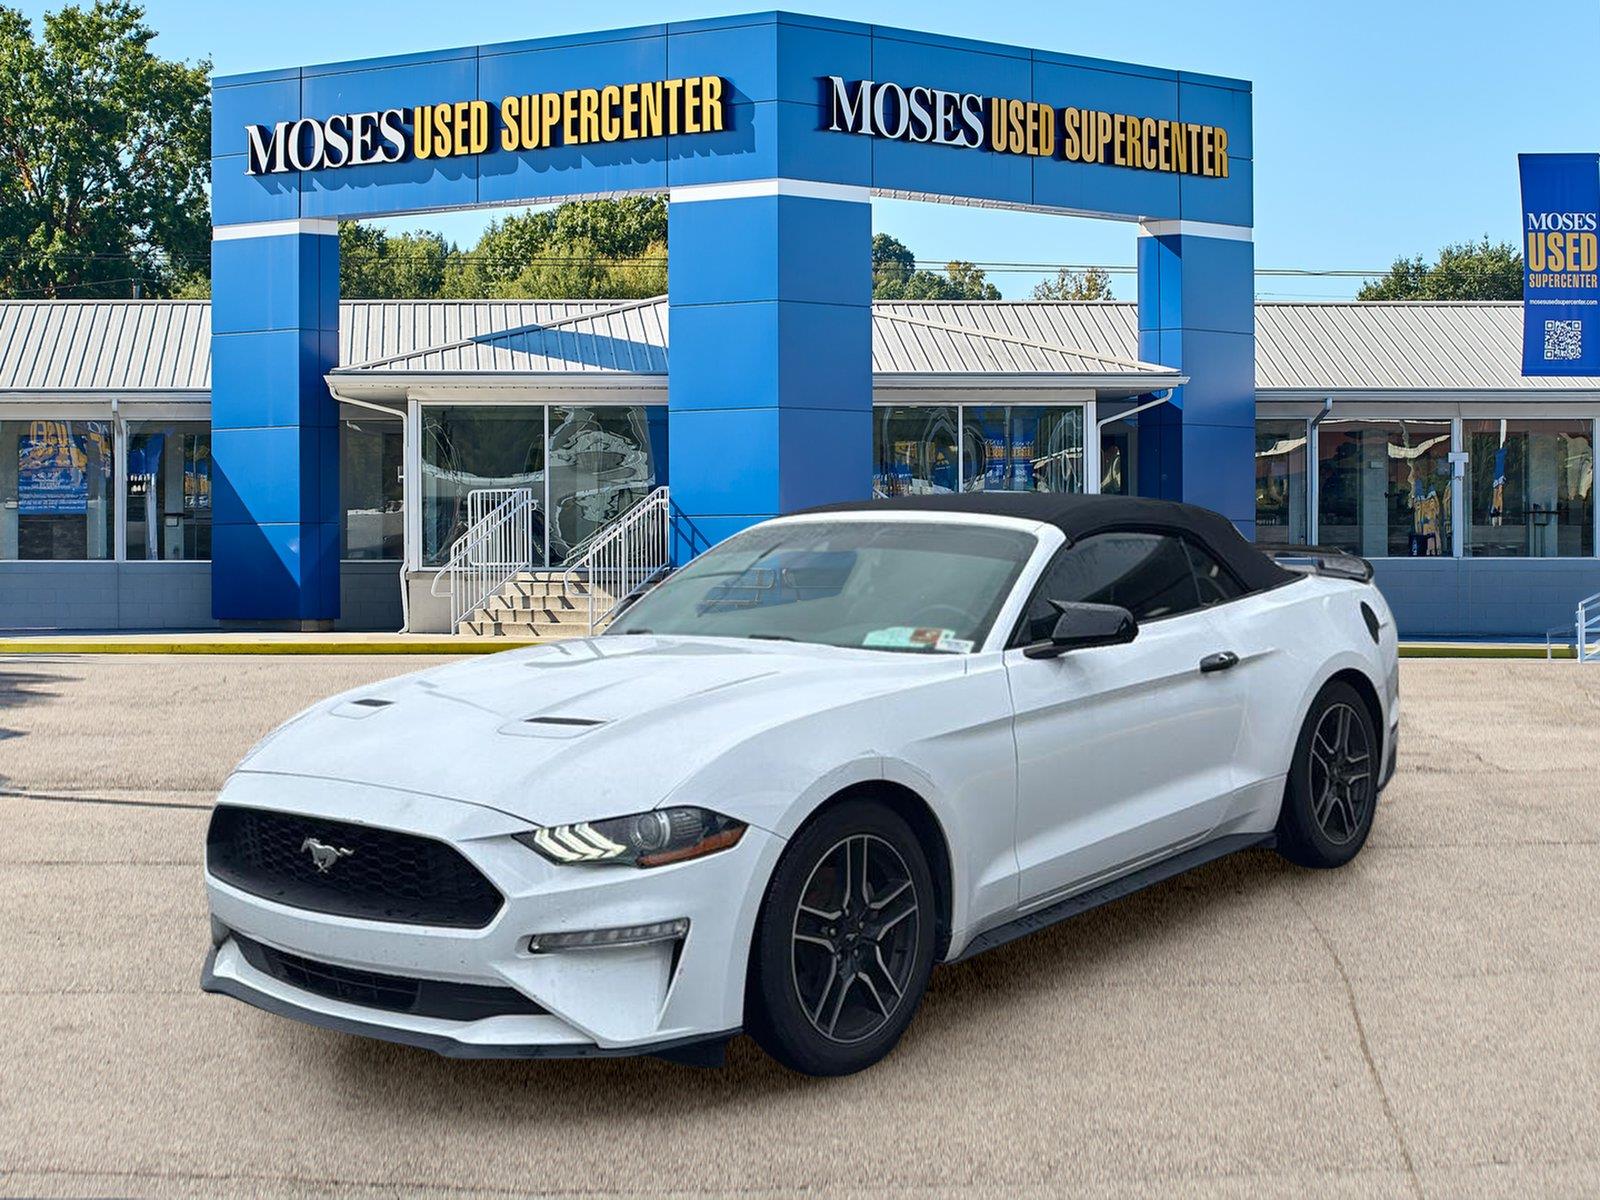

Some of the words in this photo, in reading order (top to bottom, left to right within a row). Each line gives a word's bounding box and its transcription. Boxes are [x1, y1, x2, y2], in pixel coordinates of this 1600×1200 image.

[245, 109, 406, 175] MOSES
[413, 101, 490, 160] USED
[500, 75, 724, 151] SUPERCENTER
[829, 75, 985, 149] MOSES
[991, 97, 1055, 157] USED
[1065, 107, 1230, 178] SUPERCENTER
[1527, 212, 1597, 231] MOSES
[1528, 232, 1598, 272] USED
[1529, 273, 1598, 288] SUPERCENTER
